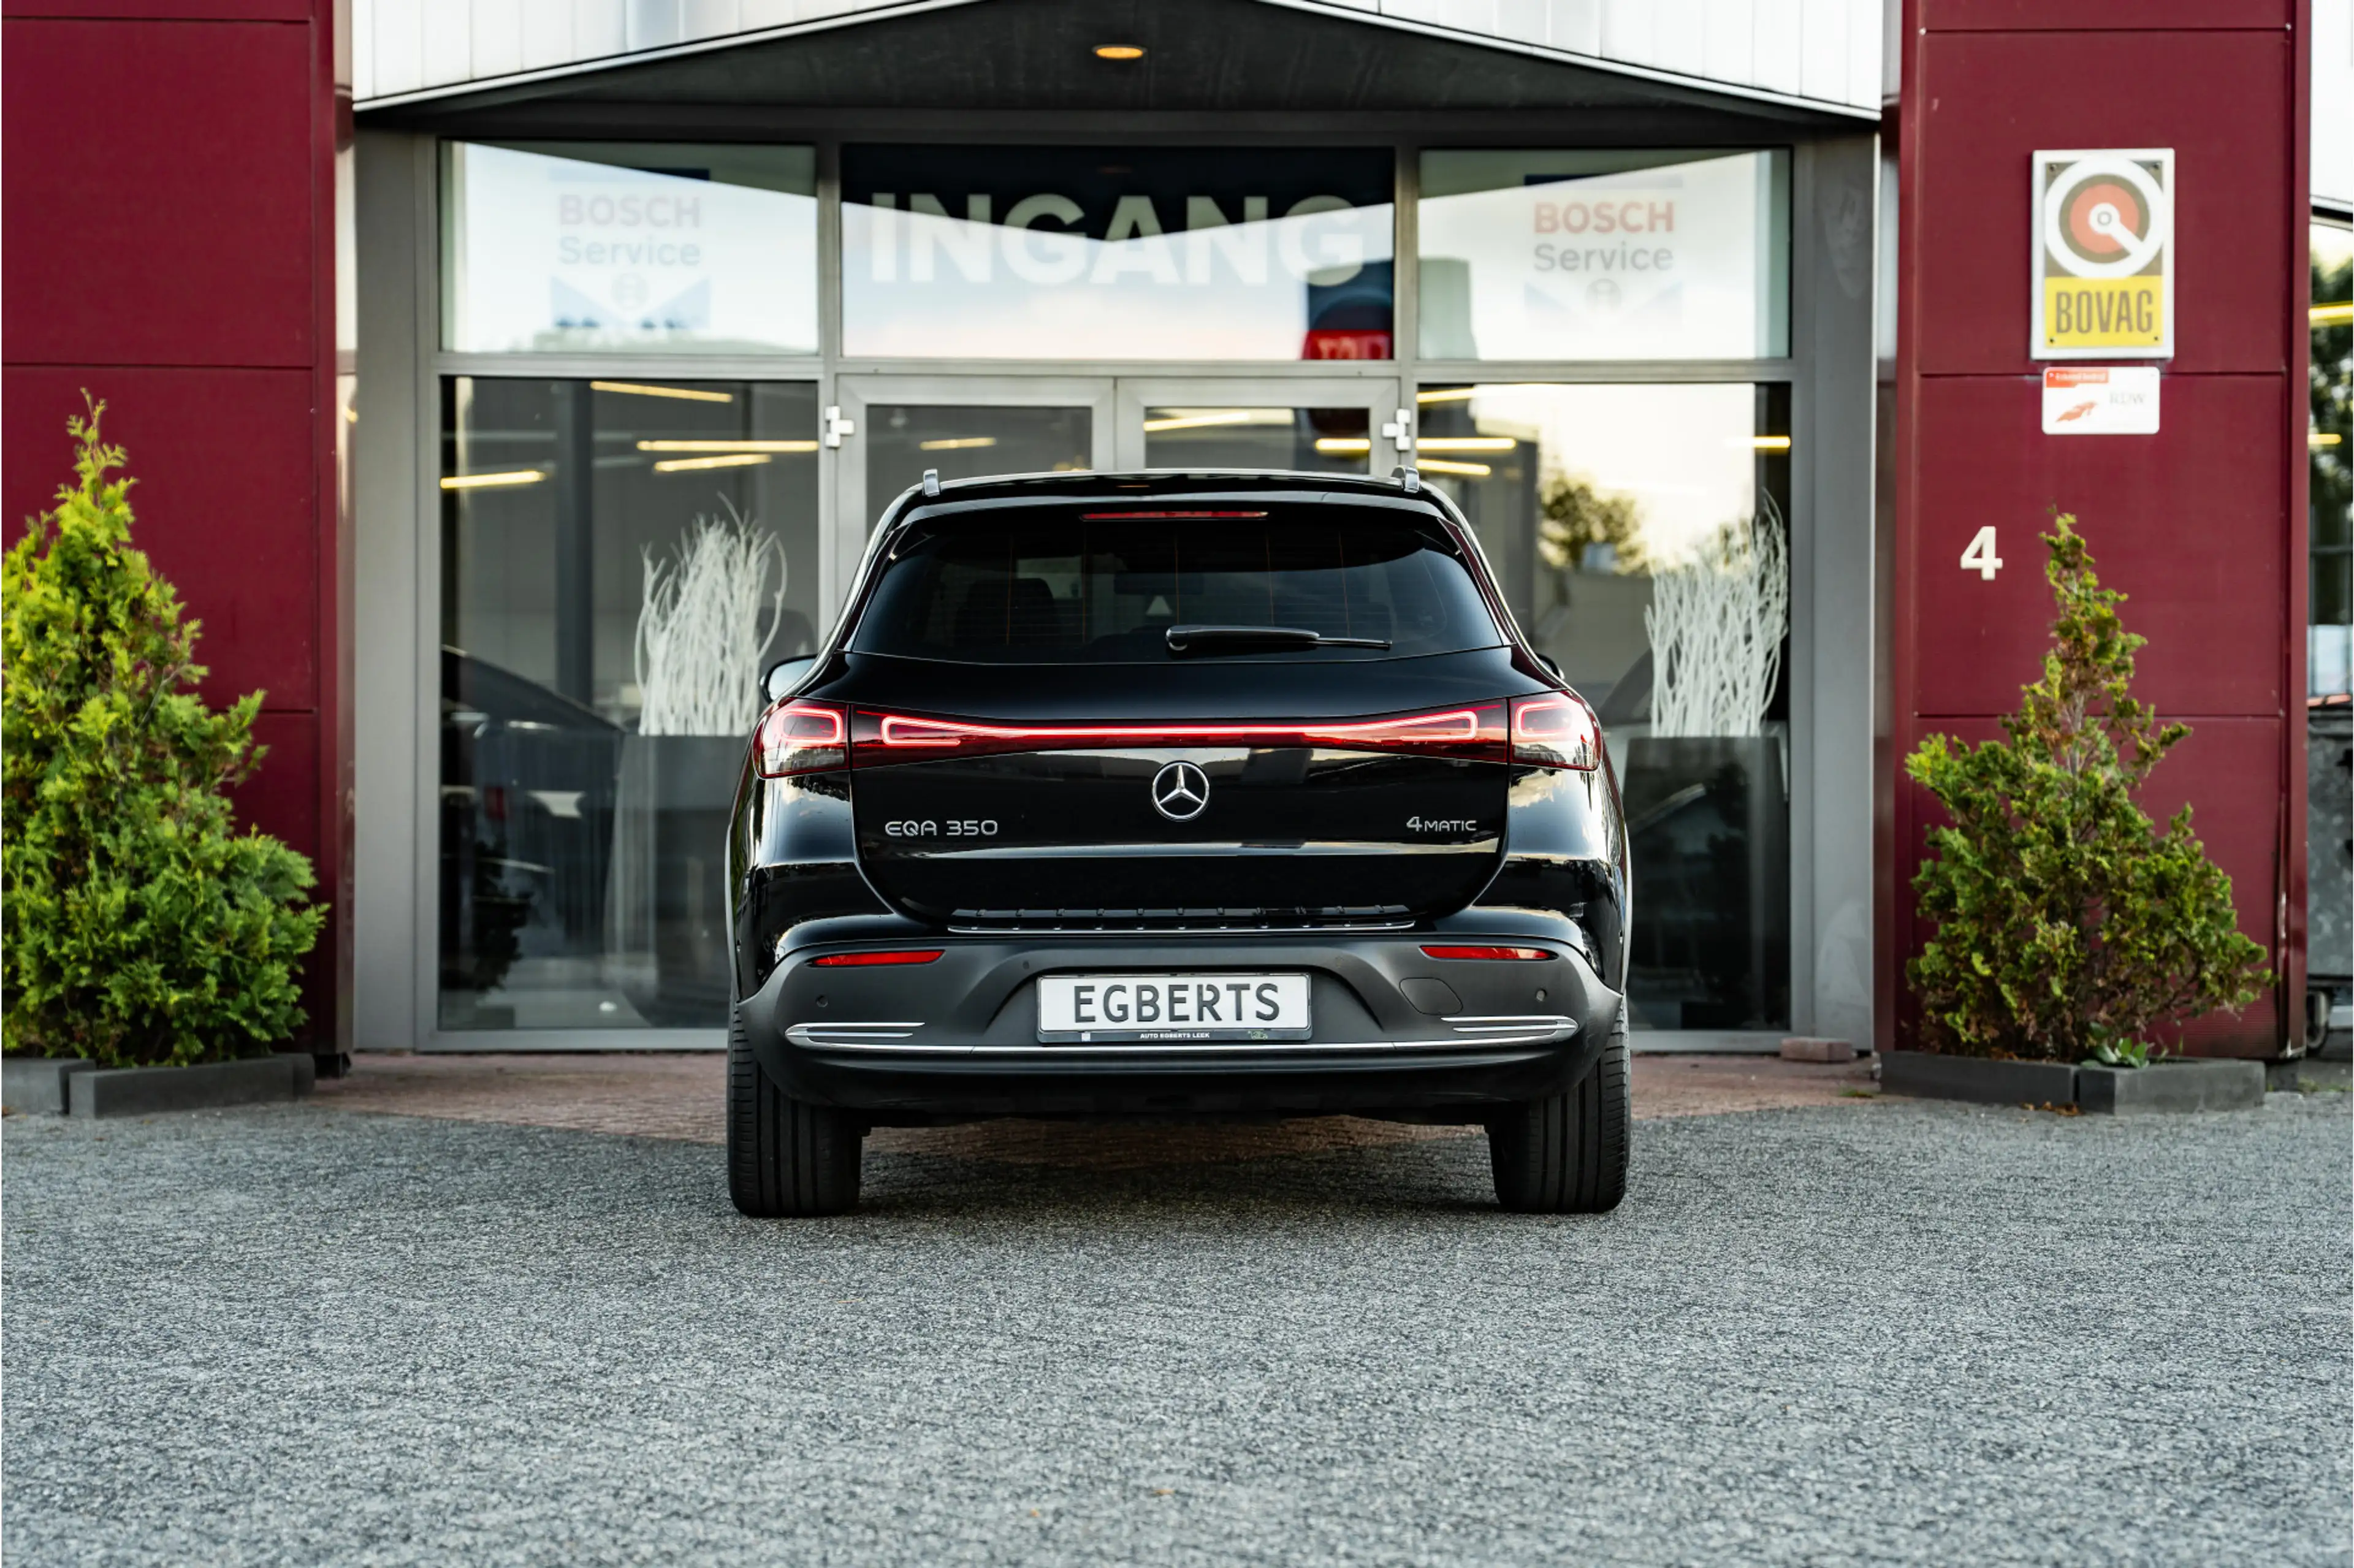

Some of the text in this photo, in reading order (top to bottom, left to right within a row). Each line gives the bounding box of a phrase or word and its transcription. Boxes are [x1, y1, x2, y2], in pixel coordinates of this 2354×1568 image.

[558, 194, 701, 229] BOSCH
[1534, 200, 1675, 235] BOSCH
[558, 234, 701, 267] Service
[870, 193, 1363, 287] INGANG
[1533, 241, 1674, 272] Service
[2055, 289, 2153, 334] BOVAG
[1960, 525, 2003, 581] 4
[885, 820, 998, 837] EQA 350
[1074, 983, 1280, 1023] EGBERTS
